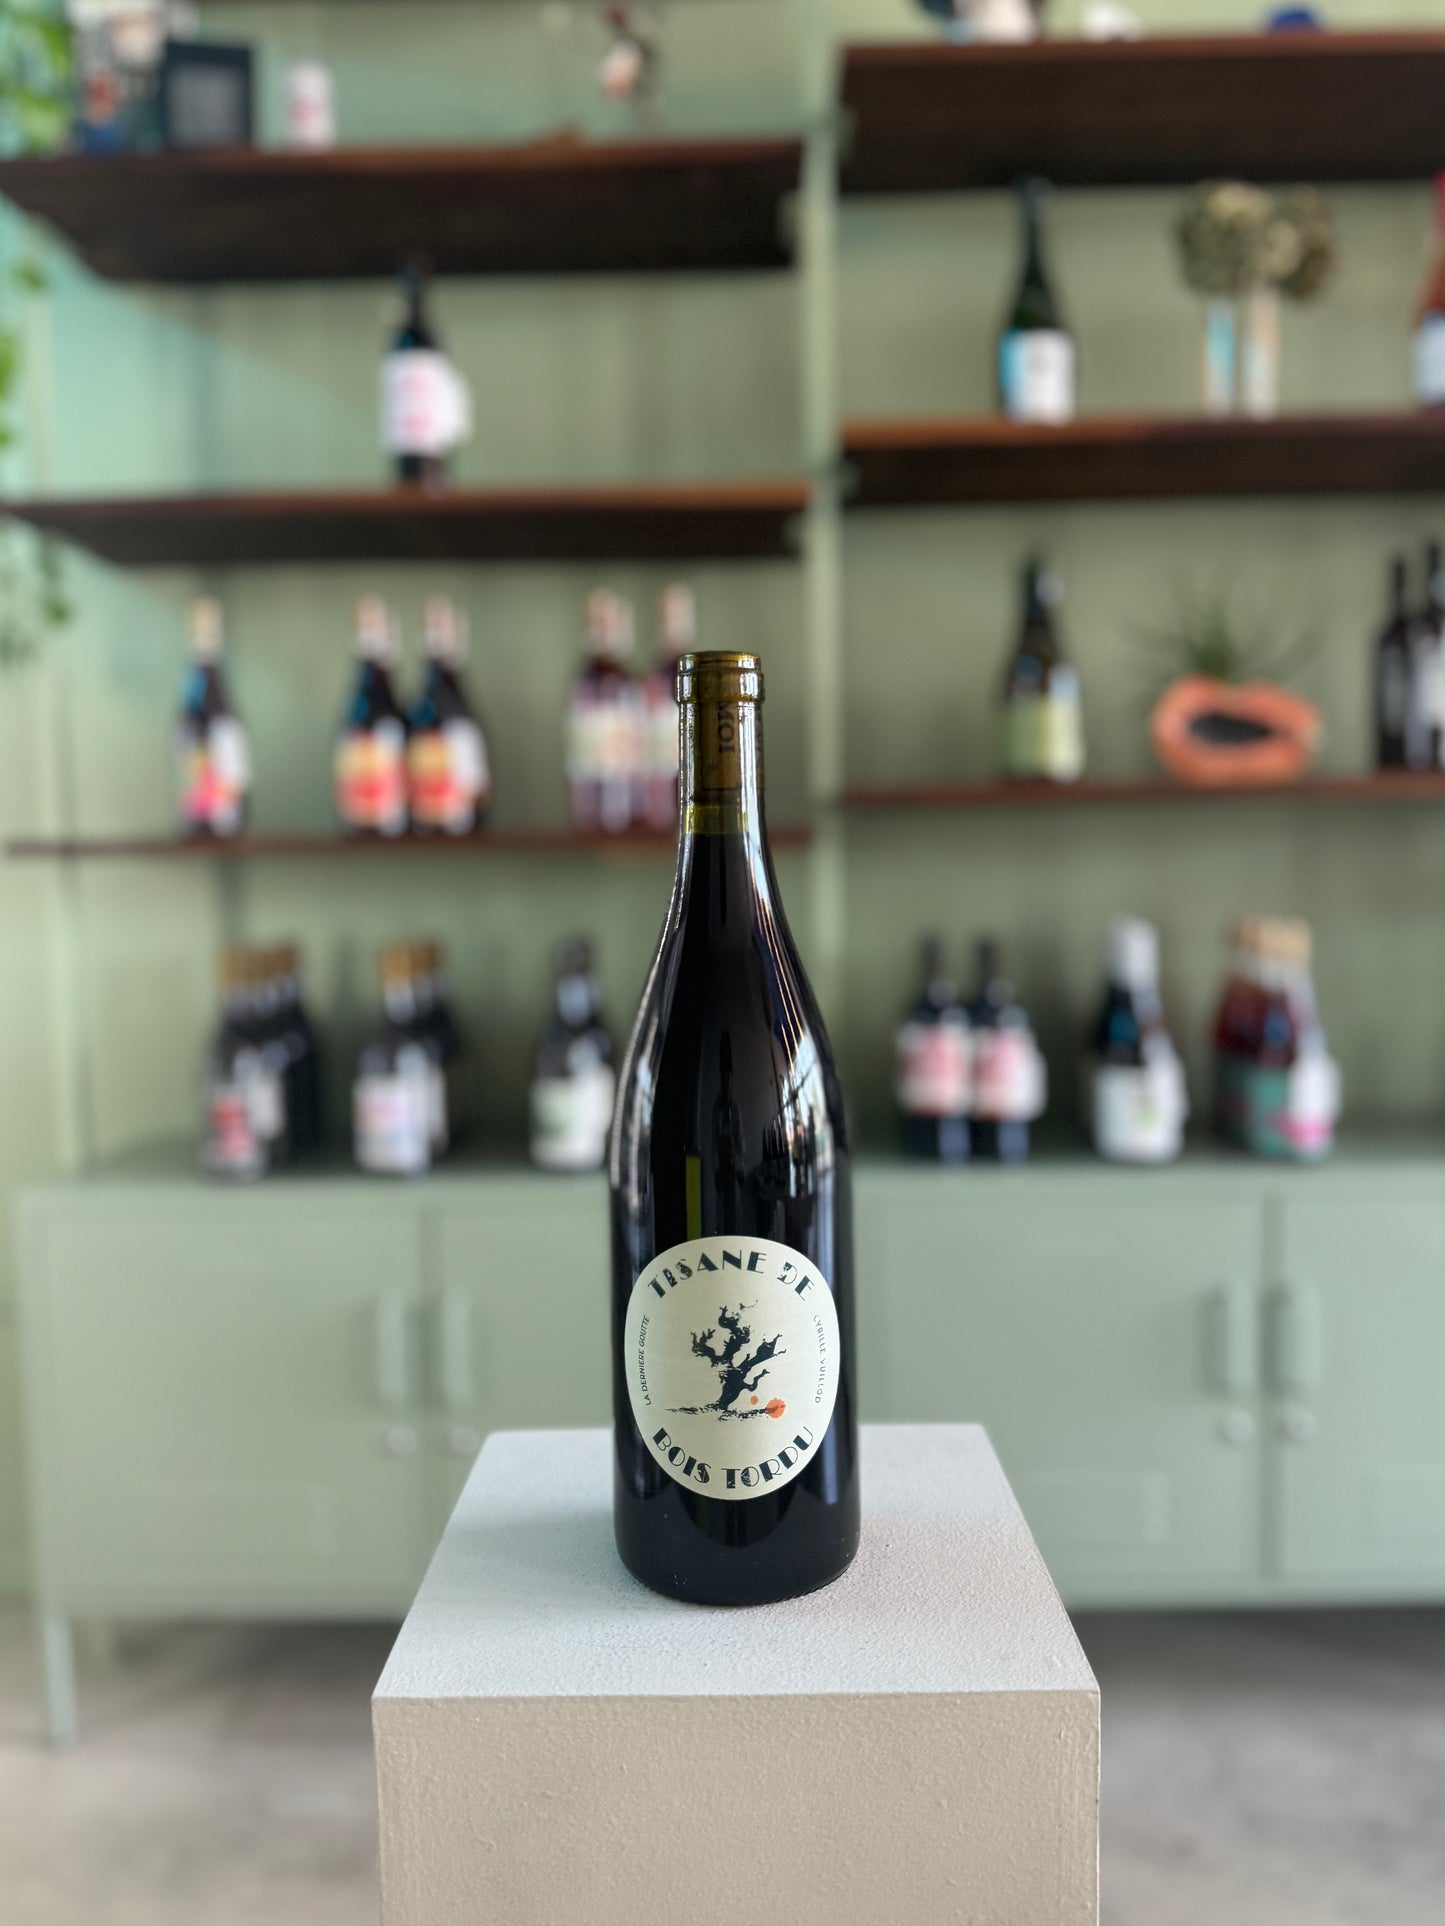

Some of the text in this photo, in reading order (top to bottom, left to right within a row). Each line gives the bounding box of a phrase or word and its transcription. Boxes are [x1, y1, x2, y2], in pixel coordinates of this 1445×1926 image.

[648, 1249, 815, 1301] TISANE DE
[638, 1315, 652, 1406] LA DERNIERE GOUTTE
[813, 1314, 826, 1404] CYRILLE VUILLOD
[652, 1426, 814, 1489] BOIS TORDU
